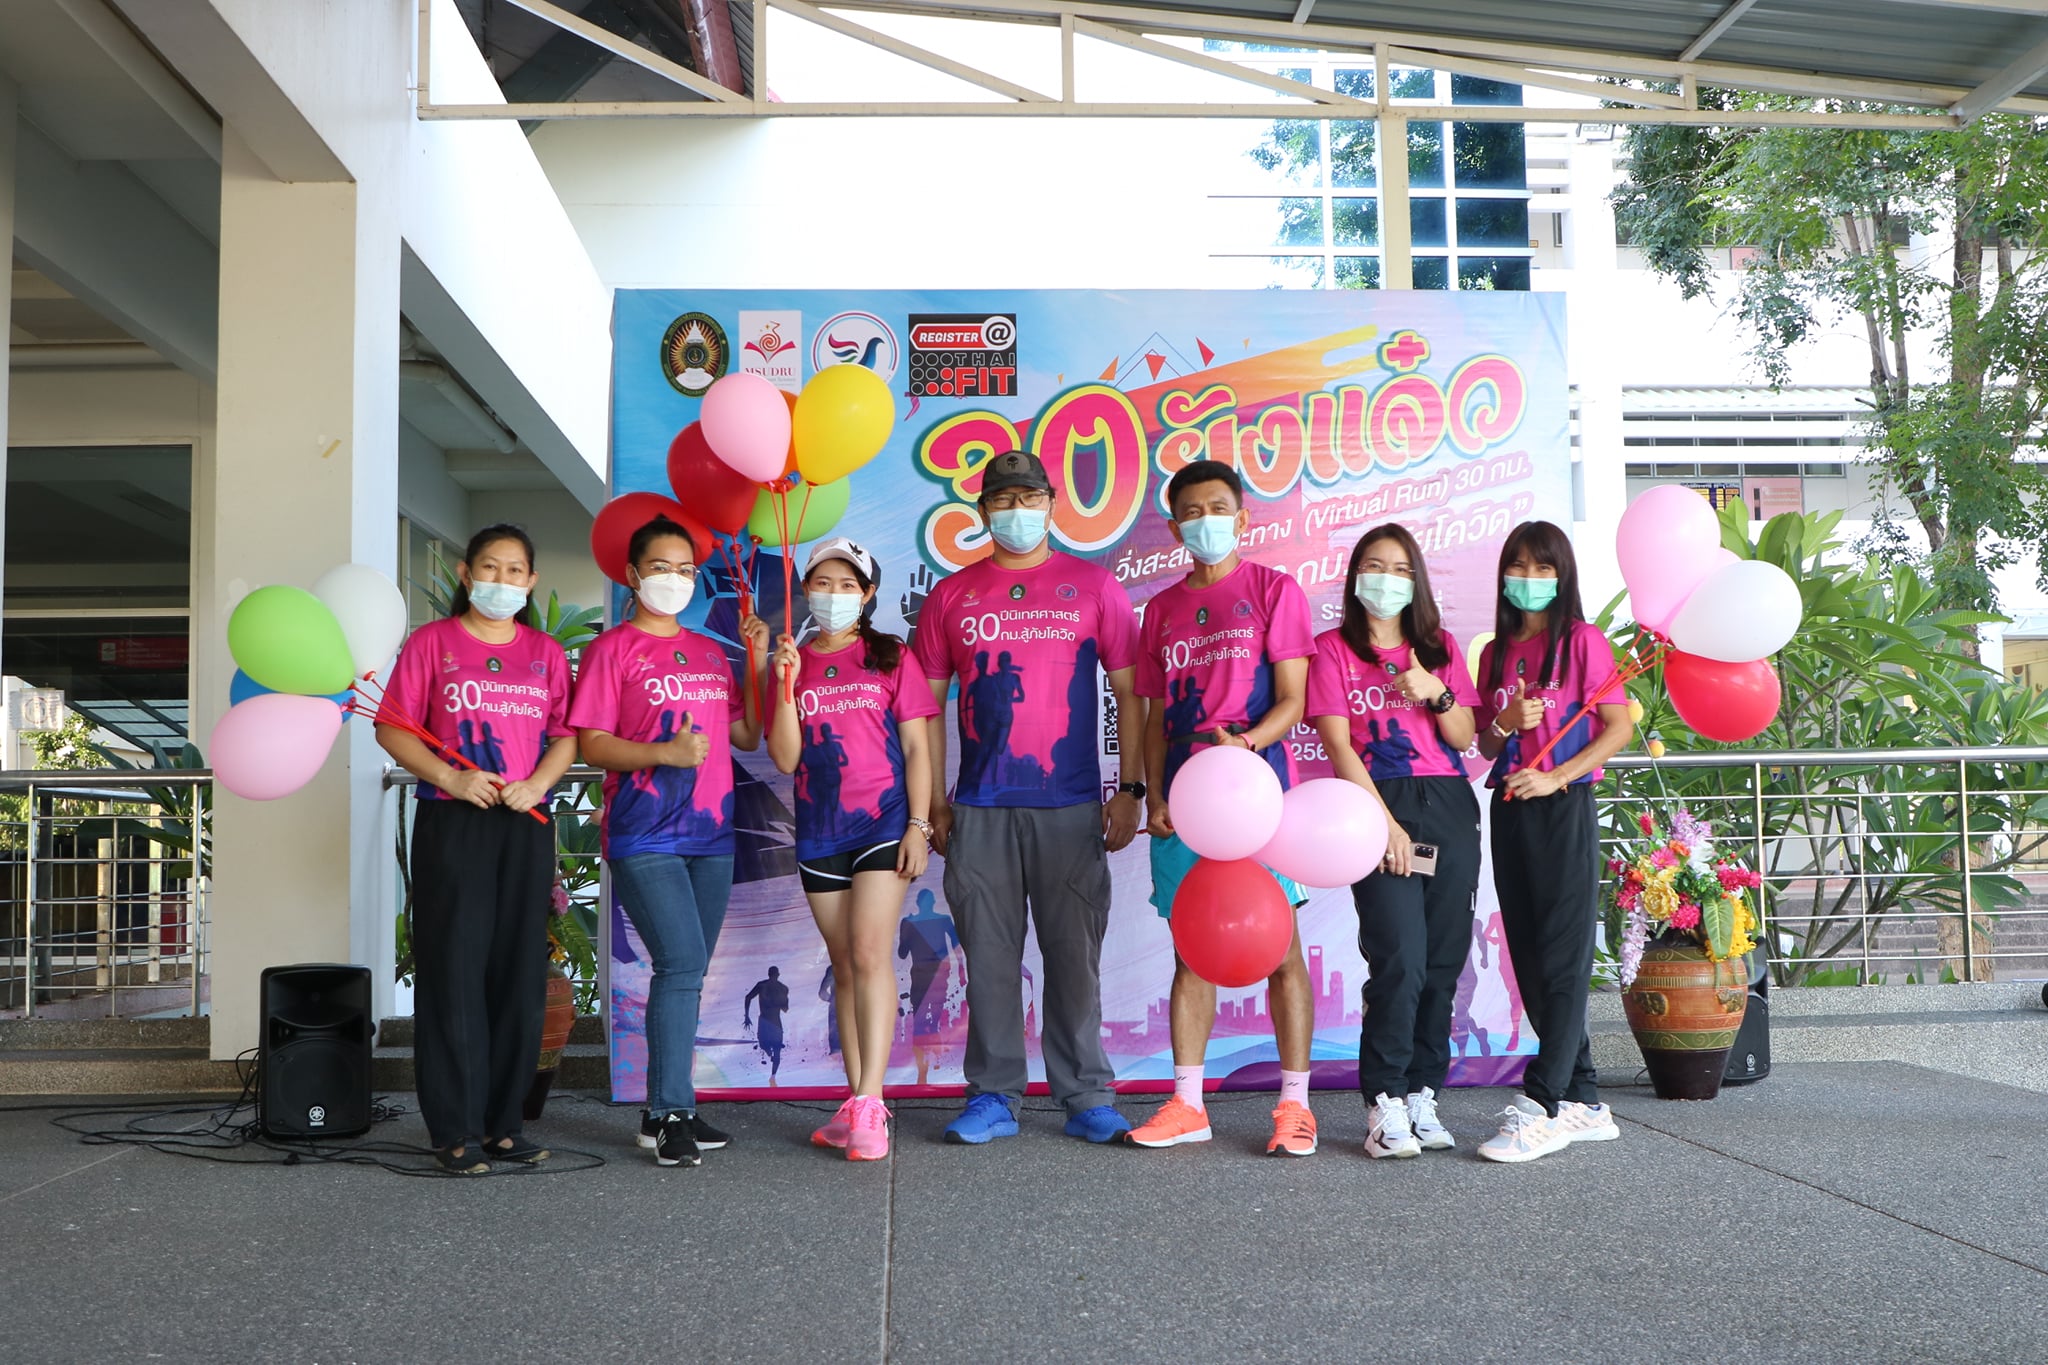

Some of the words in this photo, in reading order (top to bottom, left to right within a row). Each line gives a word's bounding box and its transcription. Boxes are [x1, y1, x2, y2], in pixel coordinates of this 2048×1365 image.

[919, 332, 979, 343] REGISTER
[985, 321, 1011, 347] @
[954, 352, 1016, 366] THAI
[954, 366, 1016, 396] FIT
[1304, 489, 1389, 536] (Virtual
[1397, 473, 1450, 506] Run)
[1454, 464, 1485, 492] 30
[1489, 455, 1529, 482] กม.
[960, 612, 1000, 646] 30
[1000, 609, 1081, 622] ปีนิเทศศาสตร์
[1001, 626, 1076, 643] กม.สู้ภัยโควิด
[1189, 626, 1254, 649] ปีนิเทศศาสตร์
[1190, 646, 1250, 667] กม.สู้ภัยโควิด
[443, 680, 482, 713] 30
[644, 675, 683, 706] 30
[1347, 686, 1385, 715] 30
[1290, 742, 1329, 761] 256
